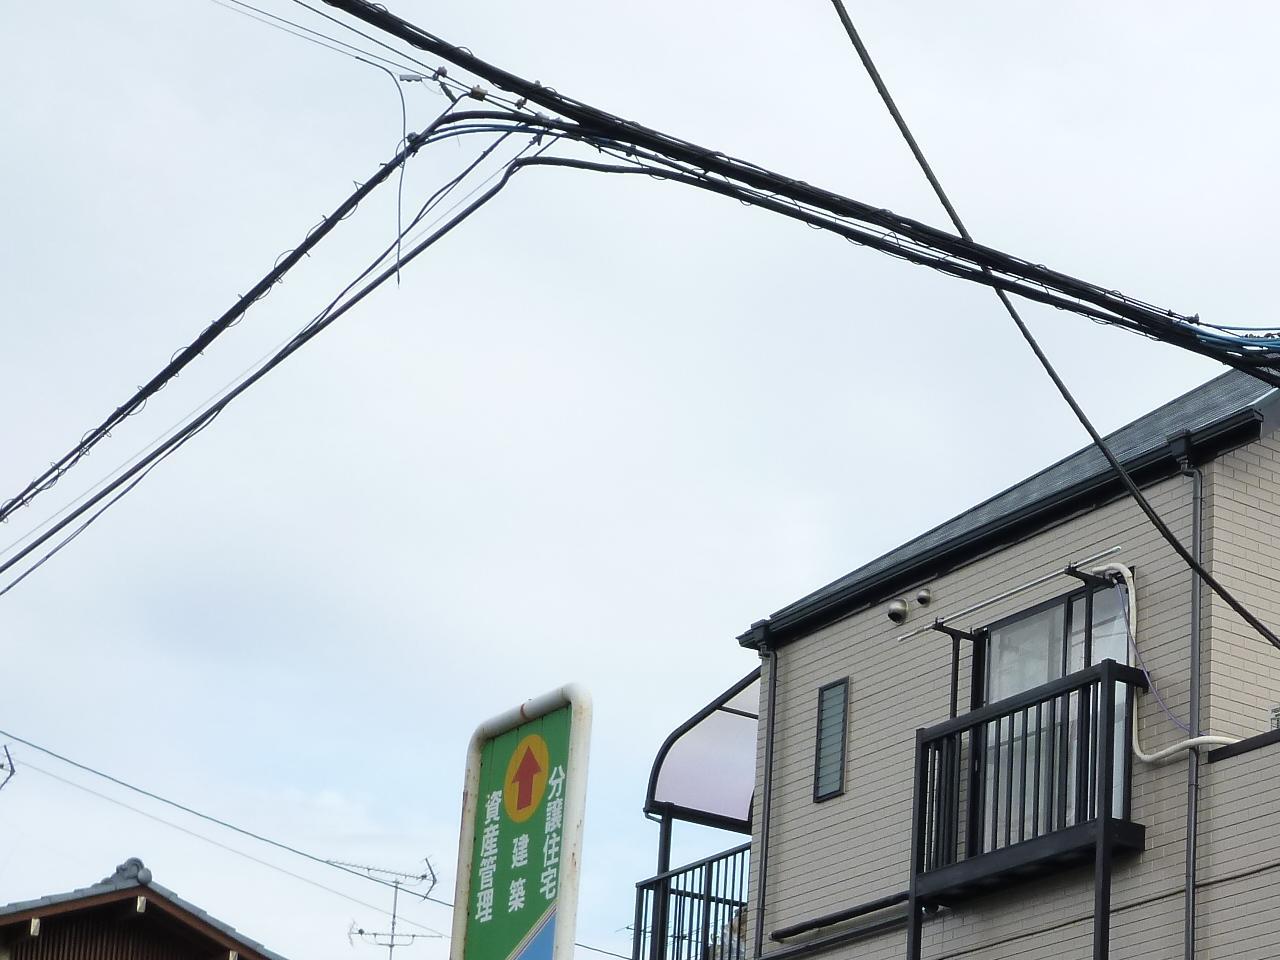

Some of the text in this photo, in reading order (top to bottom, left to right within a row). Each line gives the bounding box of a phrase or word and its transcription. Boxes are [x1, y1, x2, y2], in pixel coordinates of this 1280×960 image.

[475, 790, 502, 923] 資産管理
[508, 833, 529, 913] 建築
[540, 765, 565, 900] 分譲住宅
